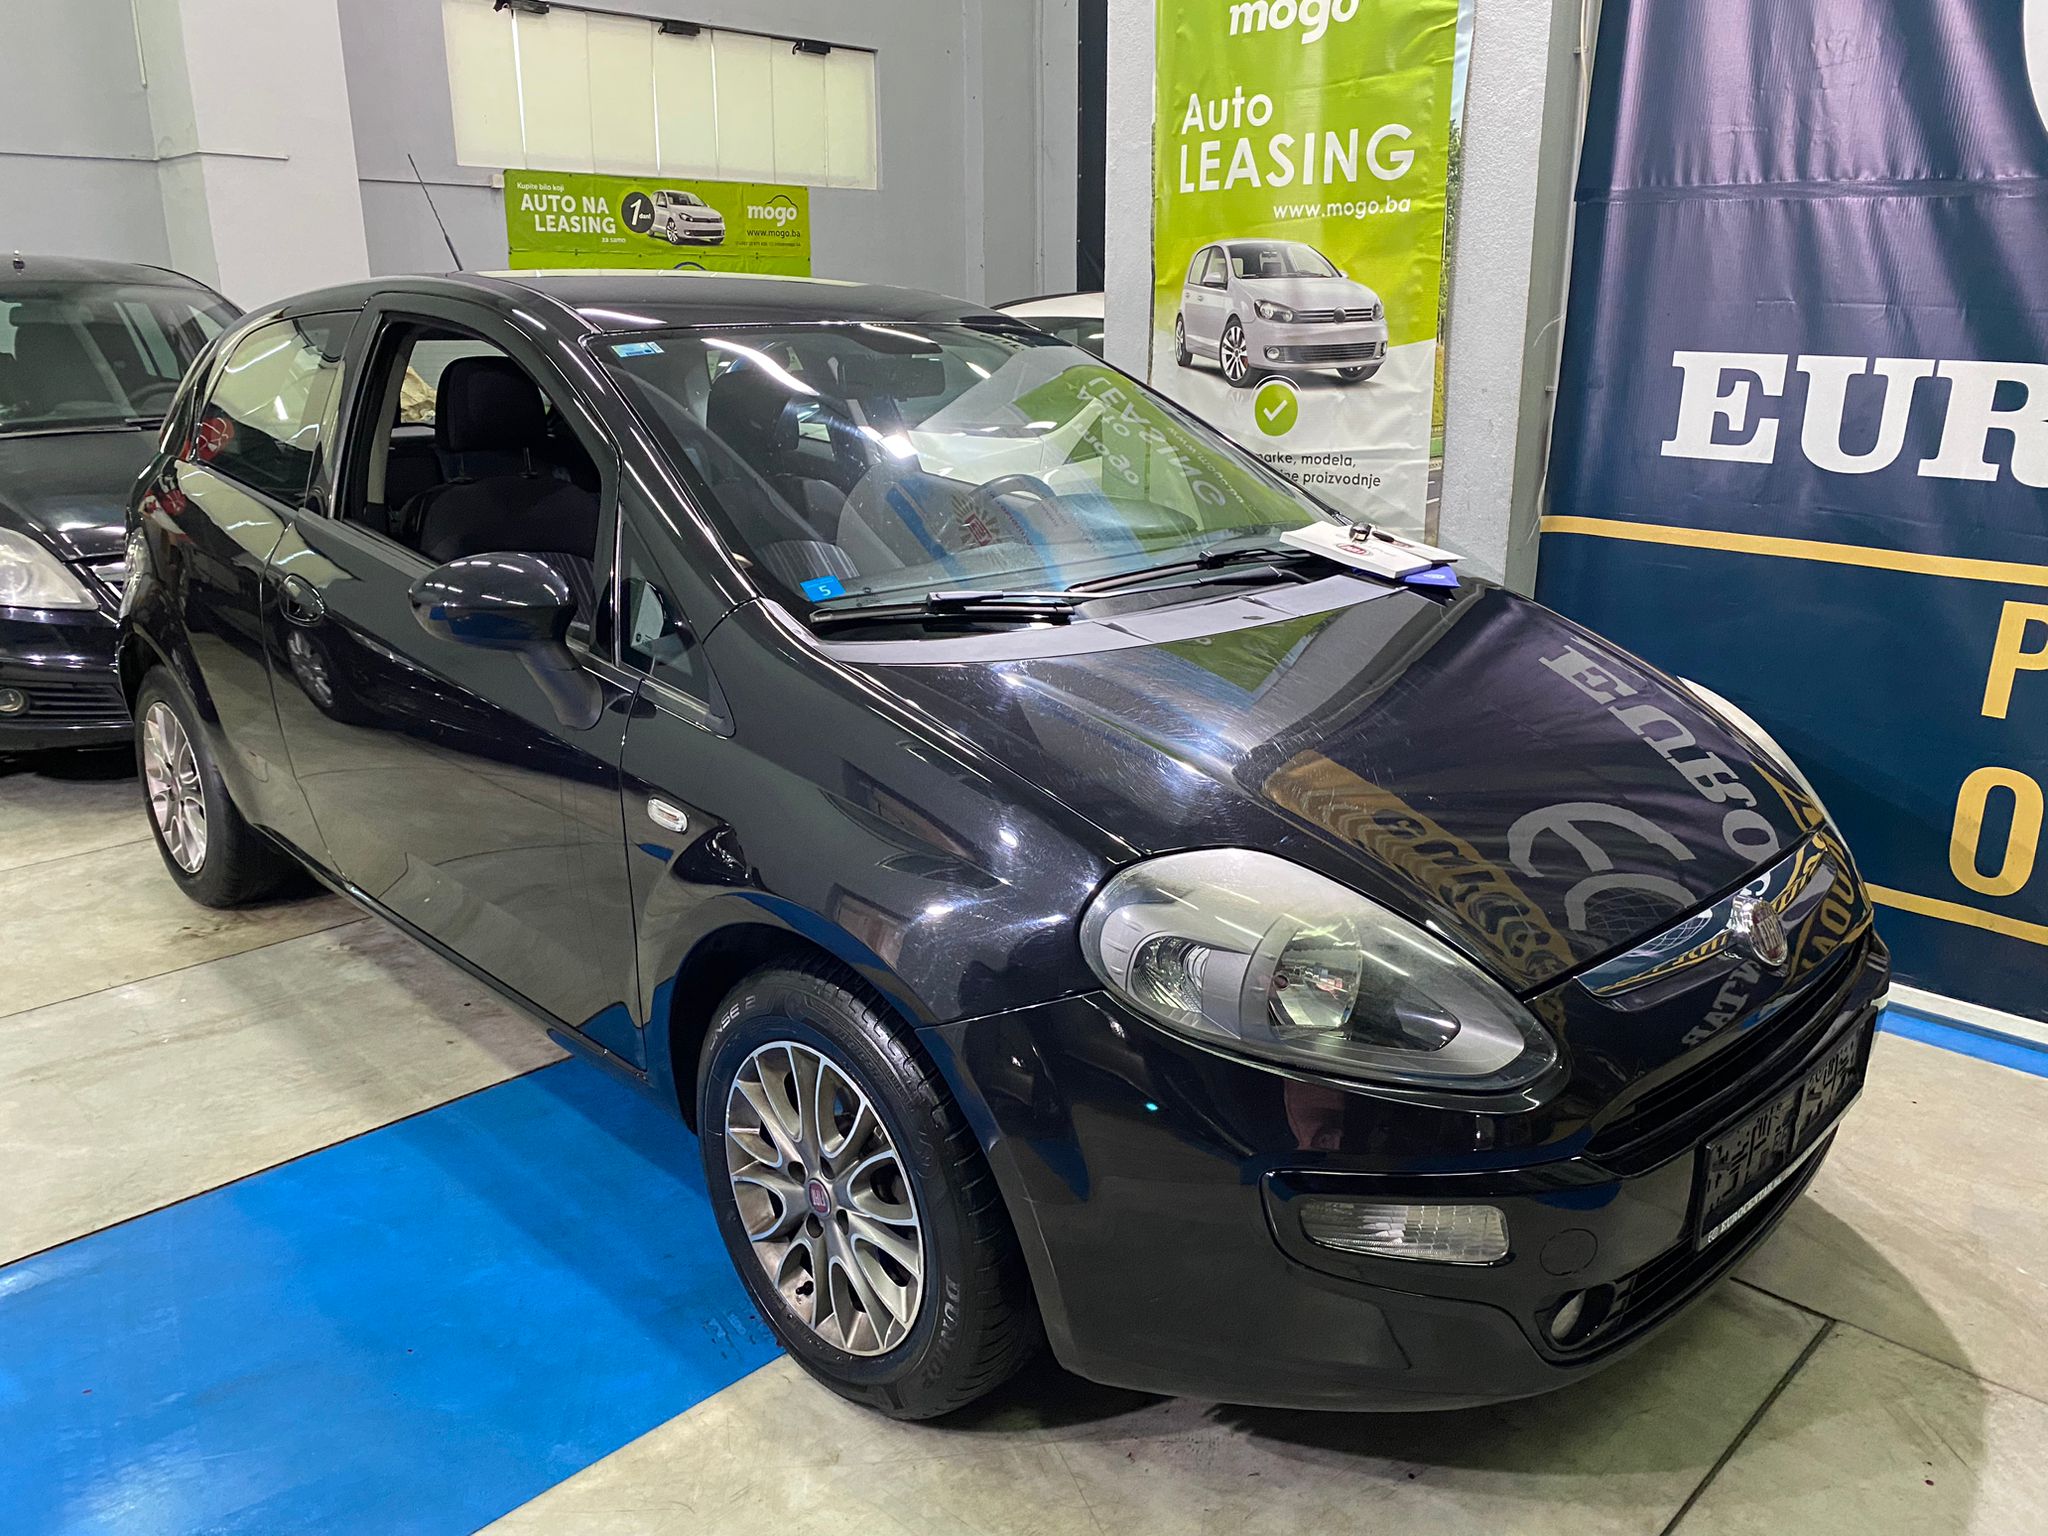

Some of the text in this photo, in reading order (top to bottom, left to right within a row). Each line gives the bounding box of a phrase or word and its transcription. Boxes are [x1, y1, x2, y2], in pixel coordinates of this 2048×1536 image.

[1229, 0, 1360, 45] mogo
[1181, 86, 1273, 135] Auto
[1179, 123, 1415, 194] LEASING
[521, 193, 609, 214] AUTO NA
[630, 199, 641, 226] 1
[1273, 195, 1411, 221] www.mogo.ba
[534, 214, 616, 235] LEASING
[747, 205, 797, 227] mogo
[746, 229, 801, 239] www.mogo.ba
[1660, 350, 2048, 489] EUR
[1301, 454, 1357, 468] modela,
[1303, 472, 1381, 489] proizvodnje
[818, 584, 832, 597] 5
